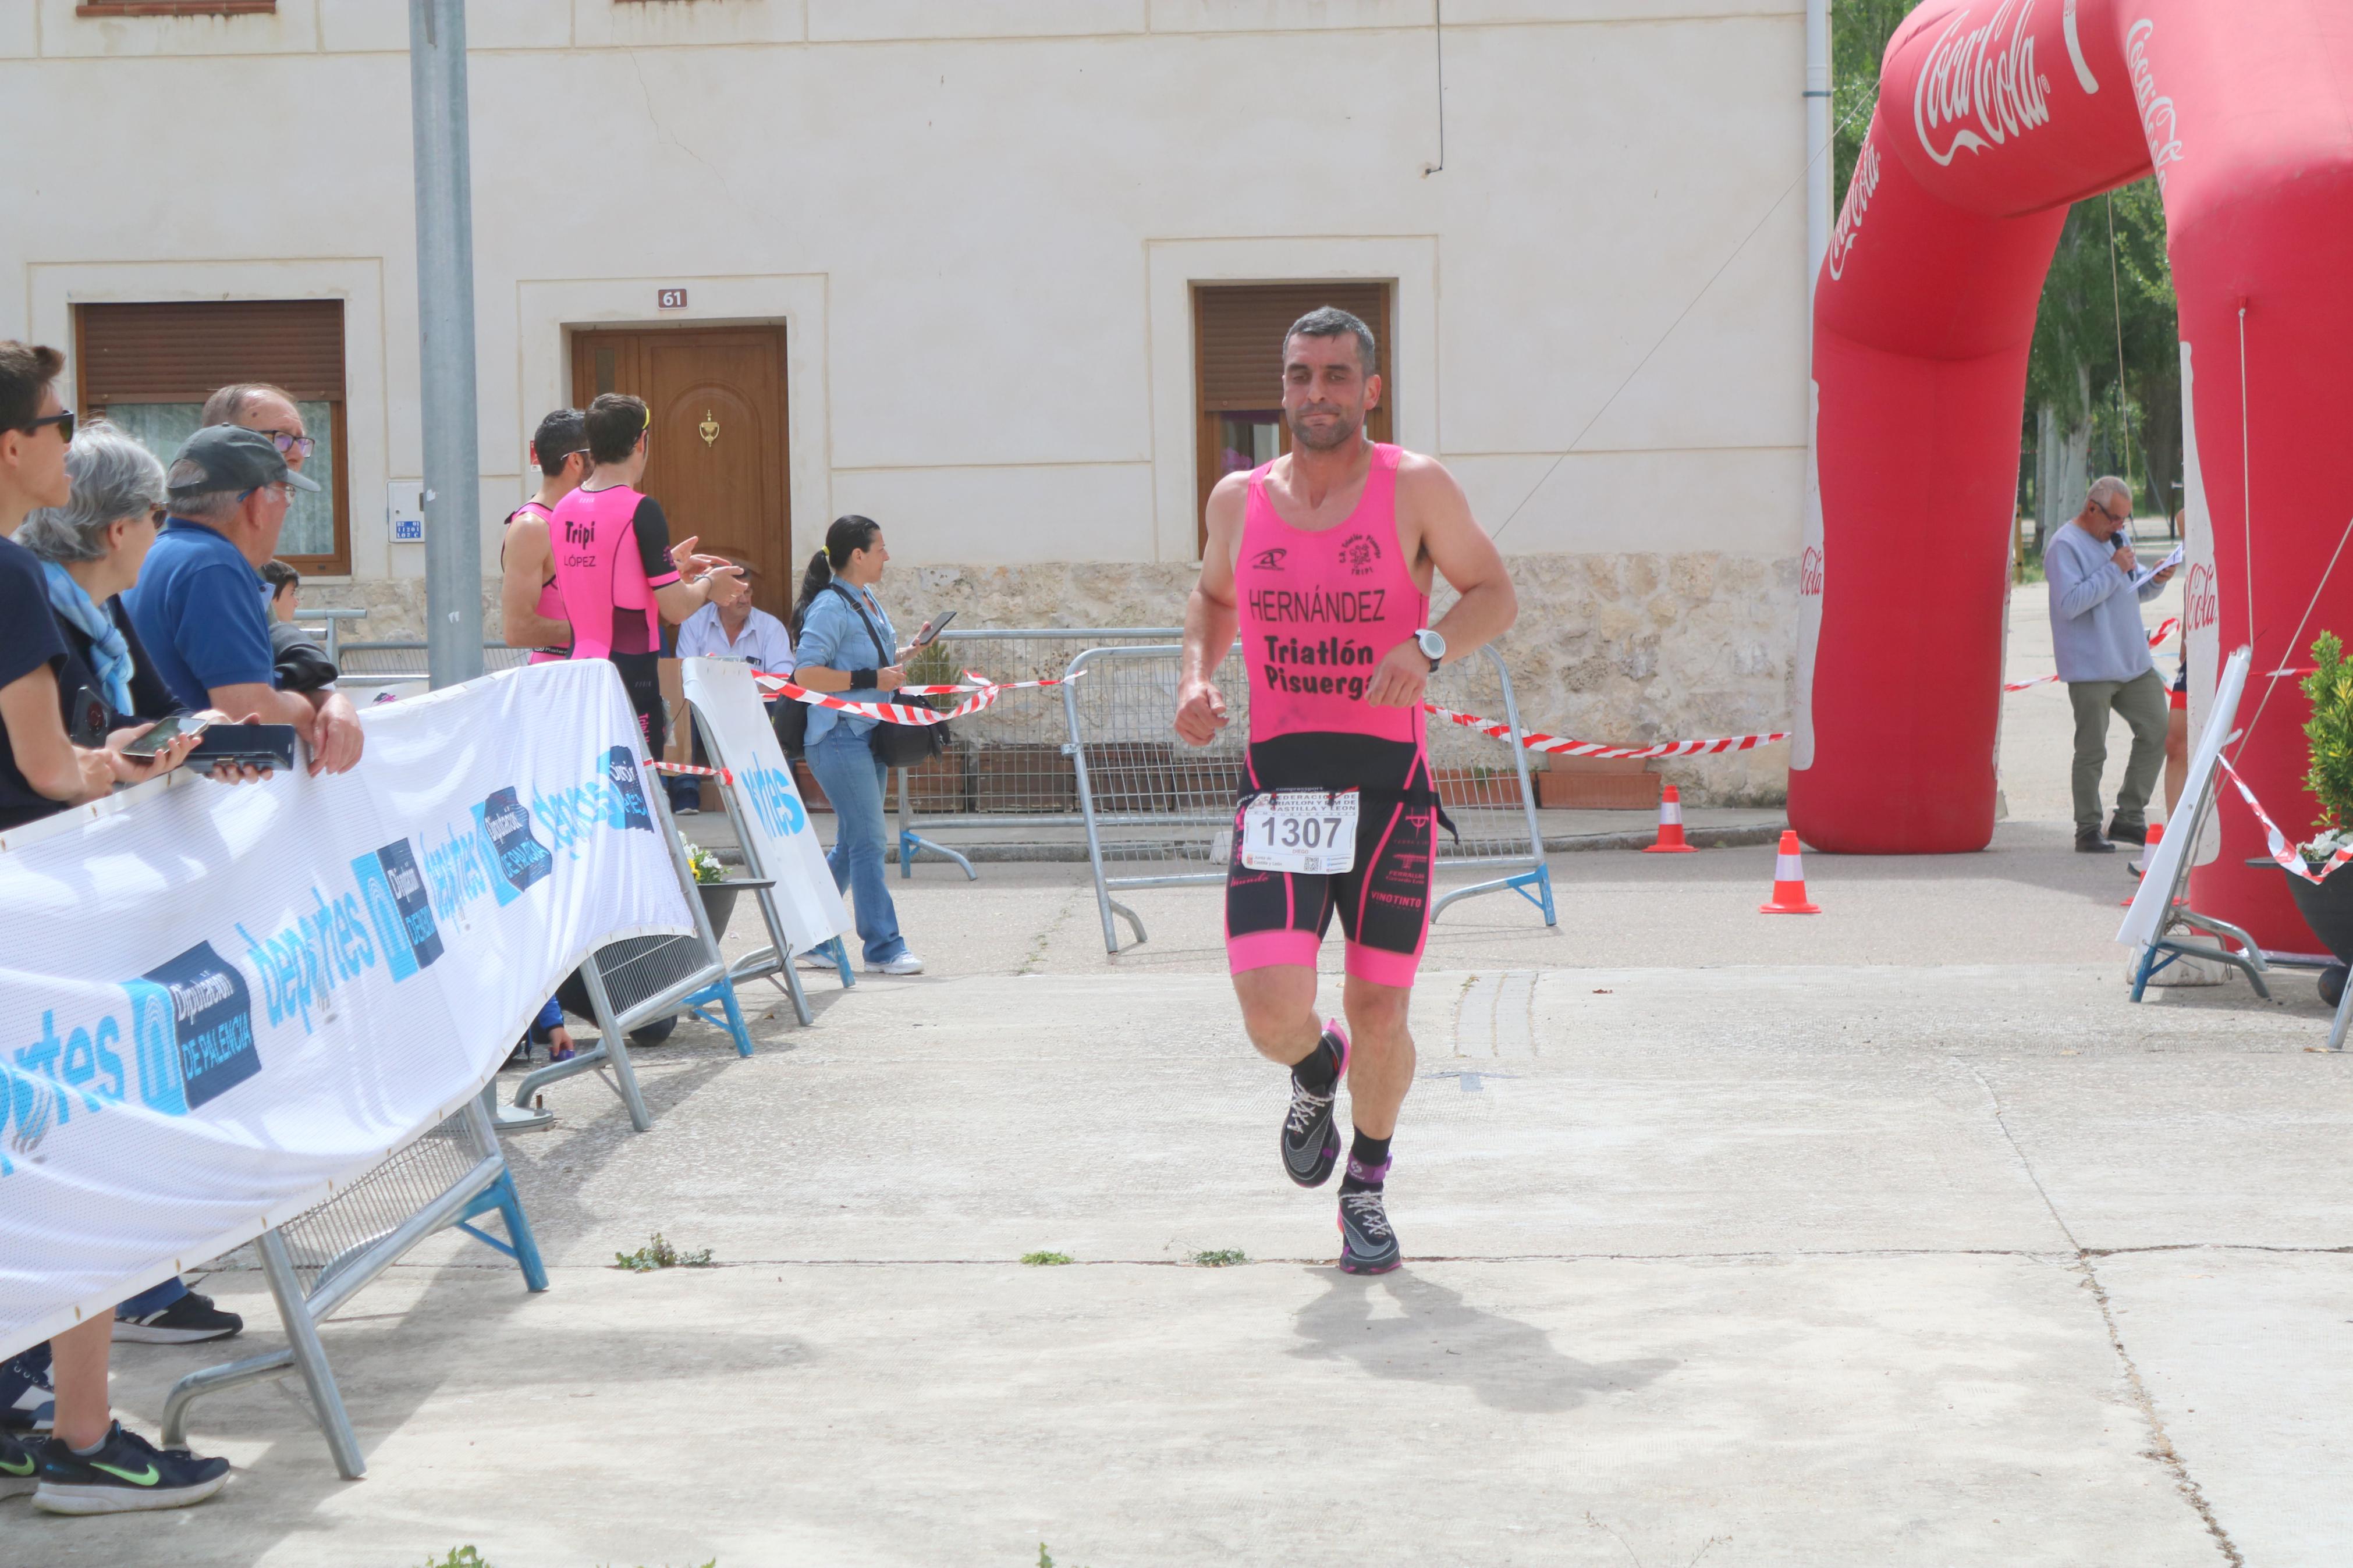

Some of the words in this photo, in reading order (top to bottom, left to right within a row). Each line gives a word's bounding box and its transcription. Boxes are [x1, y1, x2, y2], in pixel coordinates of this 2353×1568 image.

[663, 291, 681, 306] 61
[565, 521, 595, 550] Tripi
[564, 554, 596, 567] LÓPEZ
[1249, 585, 1385, 623] HERNÁNDEZ
[1264, 635, 1373, 666] Triatlón
[1261, 816, 1341, 849] 1307
[169, 970, 234, 1026] Diputación
[182, 1038, 203, 1081] DE
[198, 1012, 252, 1072] PALENCIA
